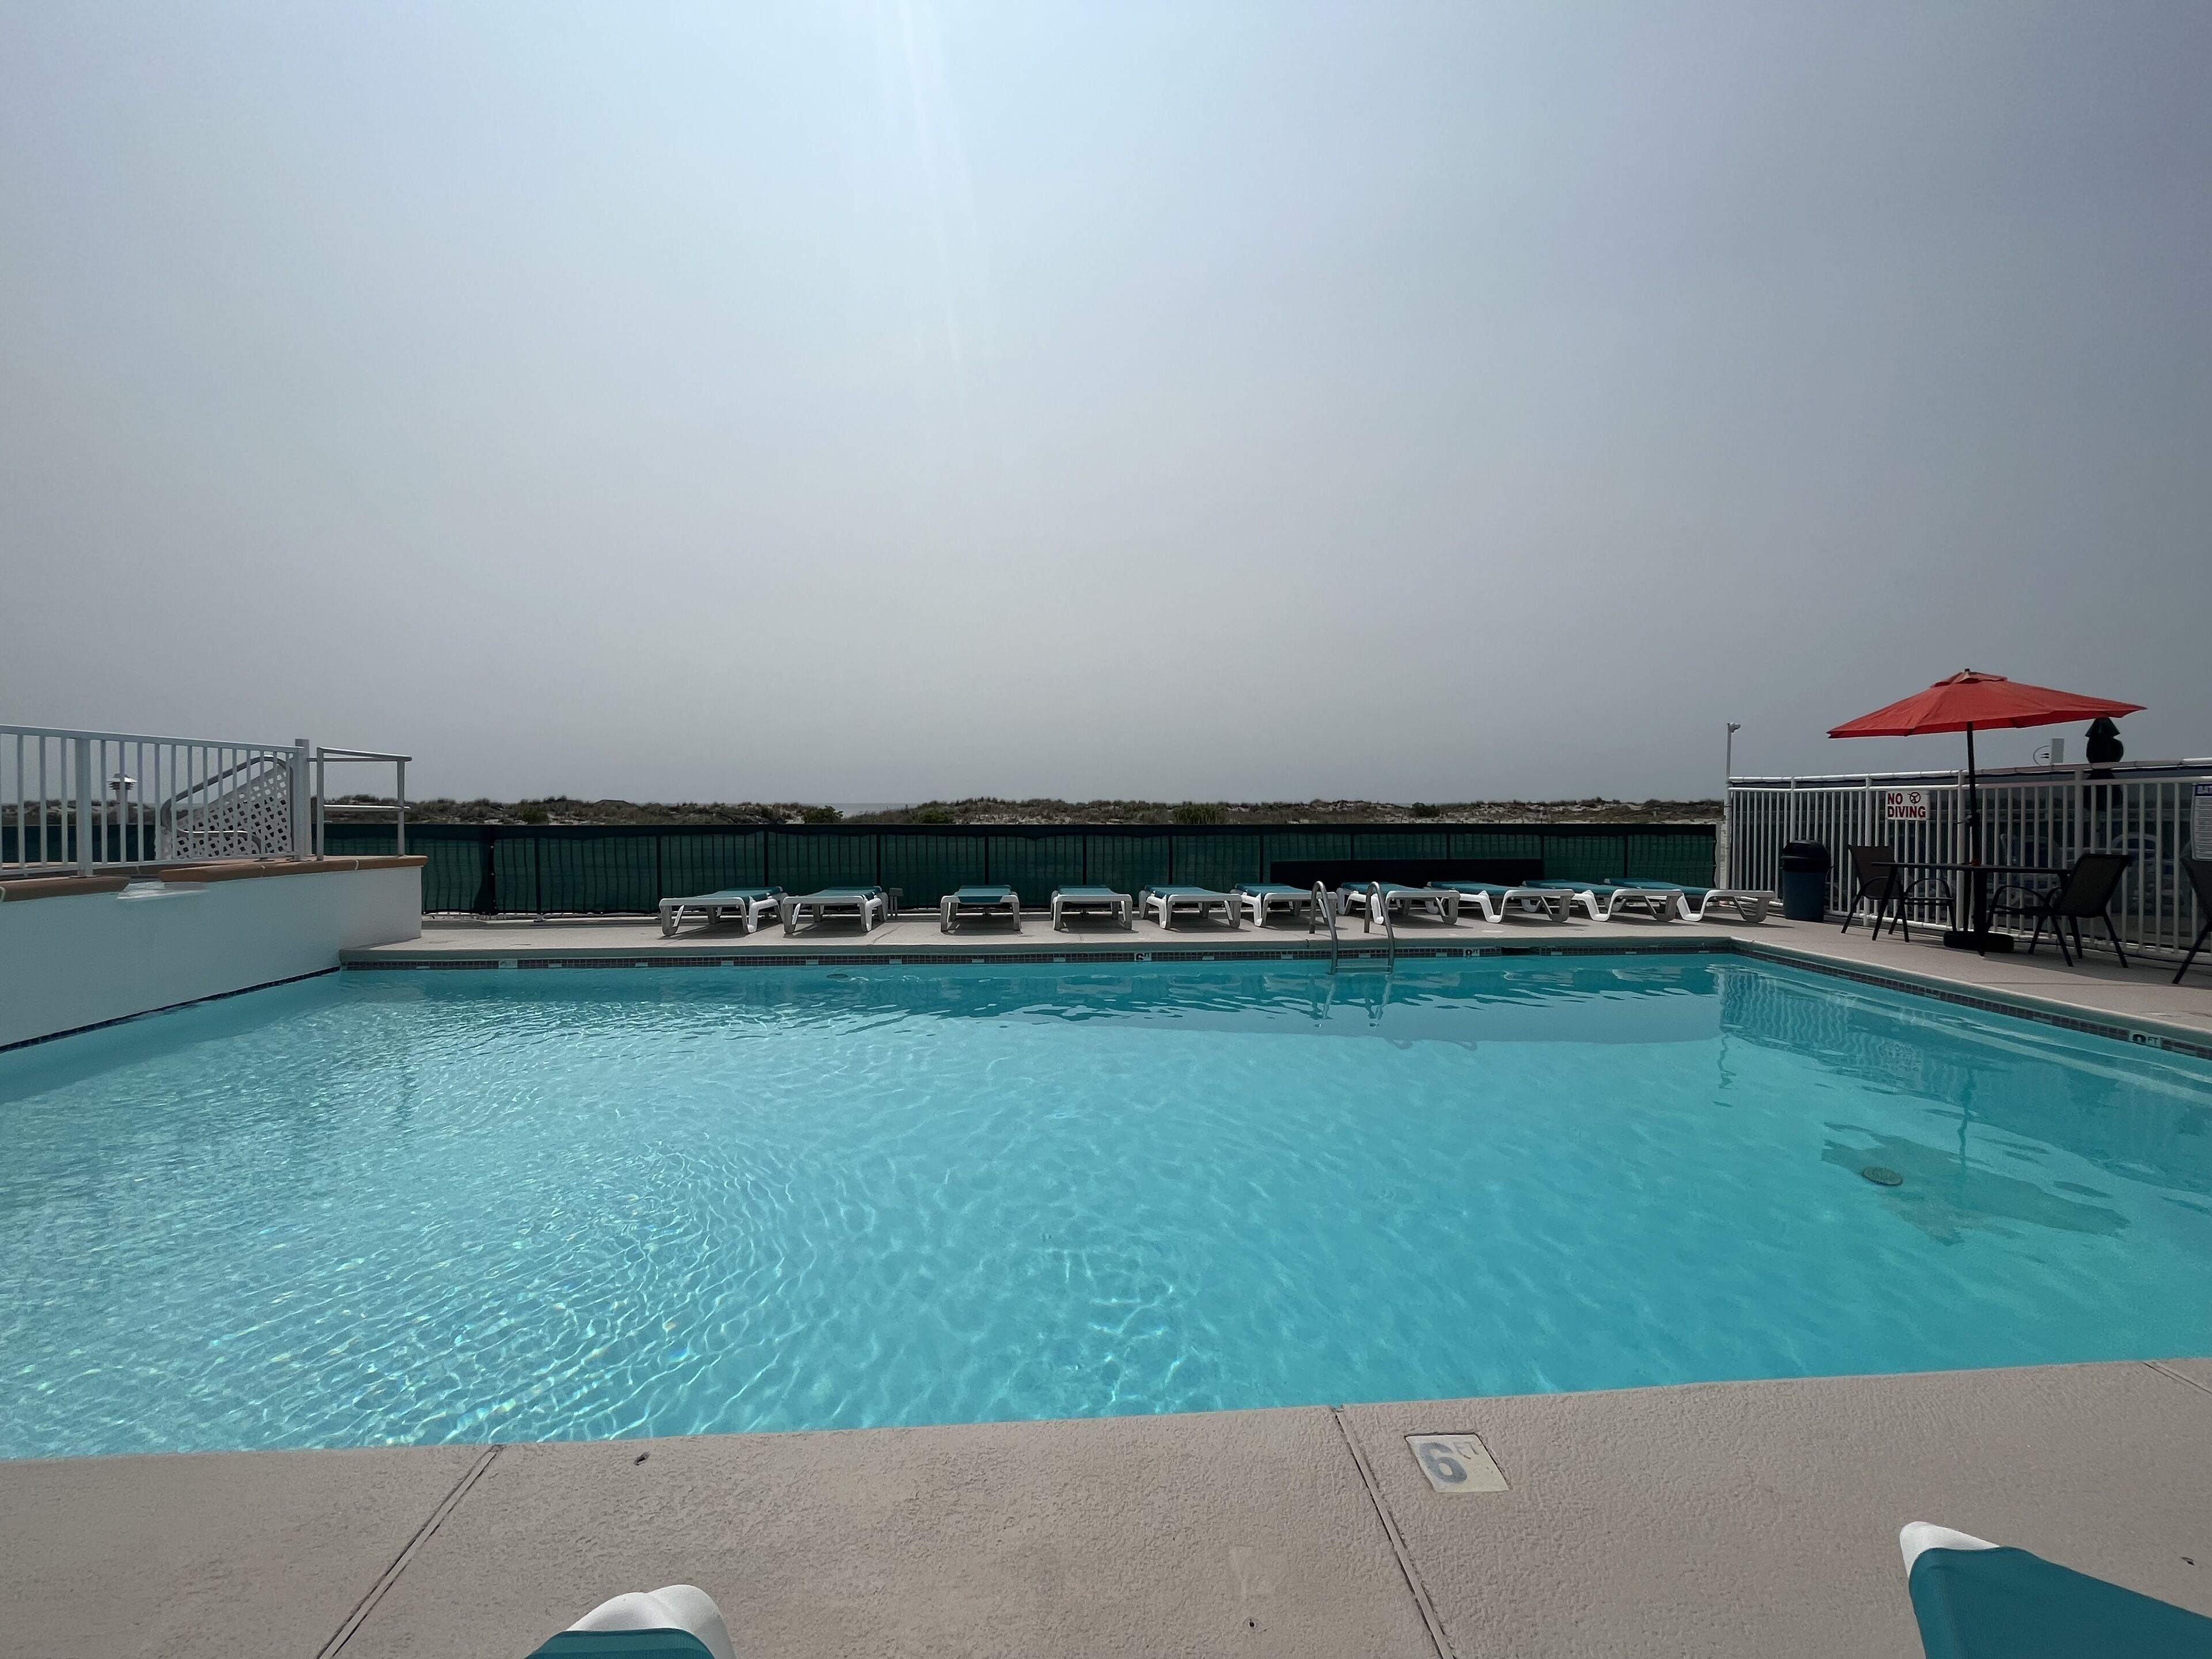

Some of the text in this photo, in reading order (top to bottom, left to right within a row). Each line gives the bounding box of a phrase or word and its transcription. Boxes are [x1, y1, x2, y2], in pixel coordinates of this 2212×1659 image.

[1888, 793, 1903, 805] NO
[1888, 806, 1926, 818] DIVING
[1419, 1442, 1468, 1484] 6
